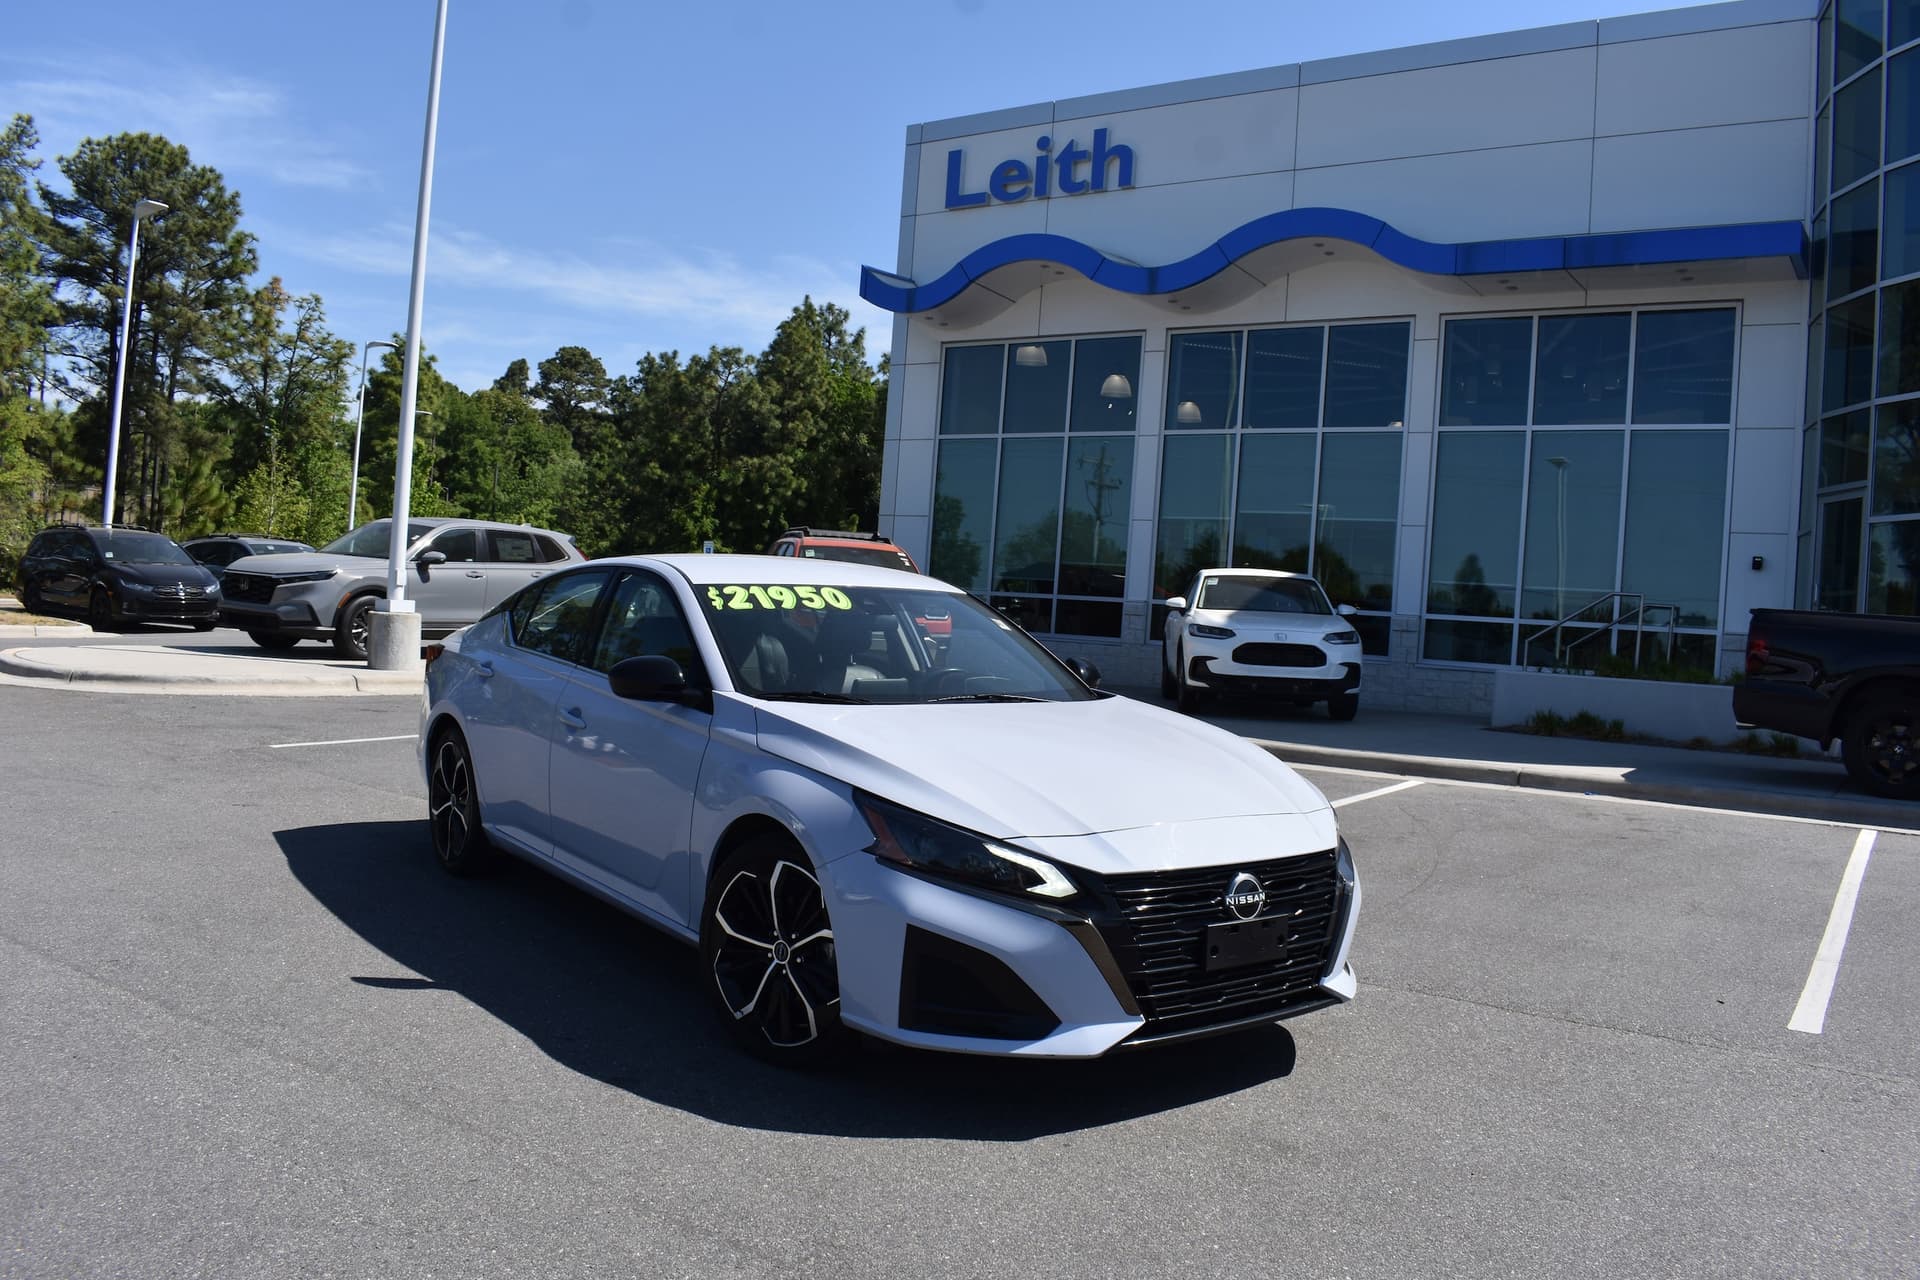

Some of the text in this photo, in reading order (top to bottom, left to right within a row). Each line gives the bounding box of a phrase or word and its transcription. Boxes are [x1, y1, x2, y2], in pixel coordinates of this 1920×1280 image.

[945, 127, 1134, 210] Leith
[707, 585, 853, 611] $21950
[1226, 892, 1265, 905] NISSAN
